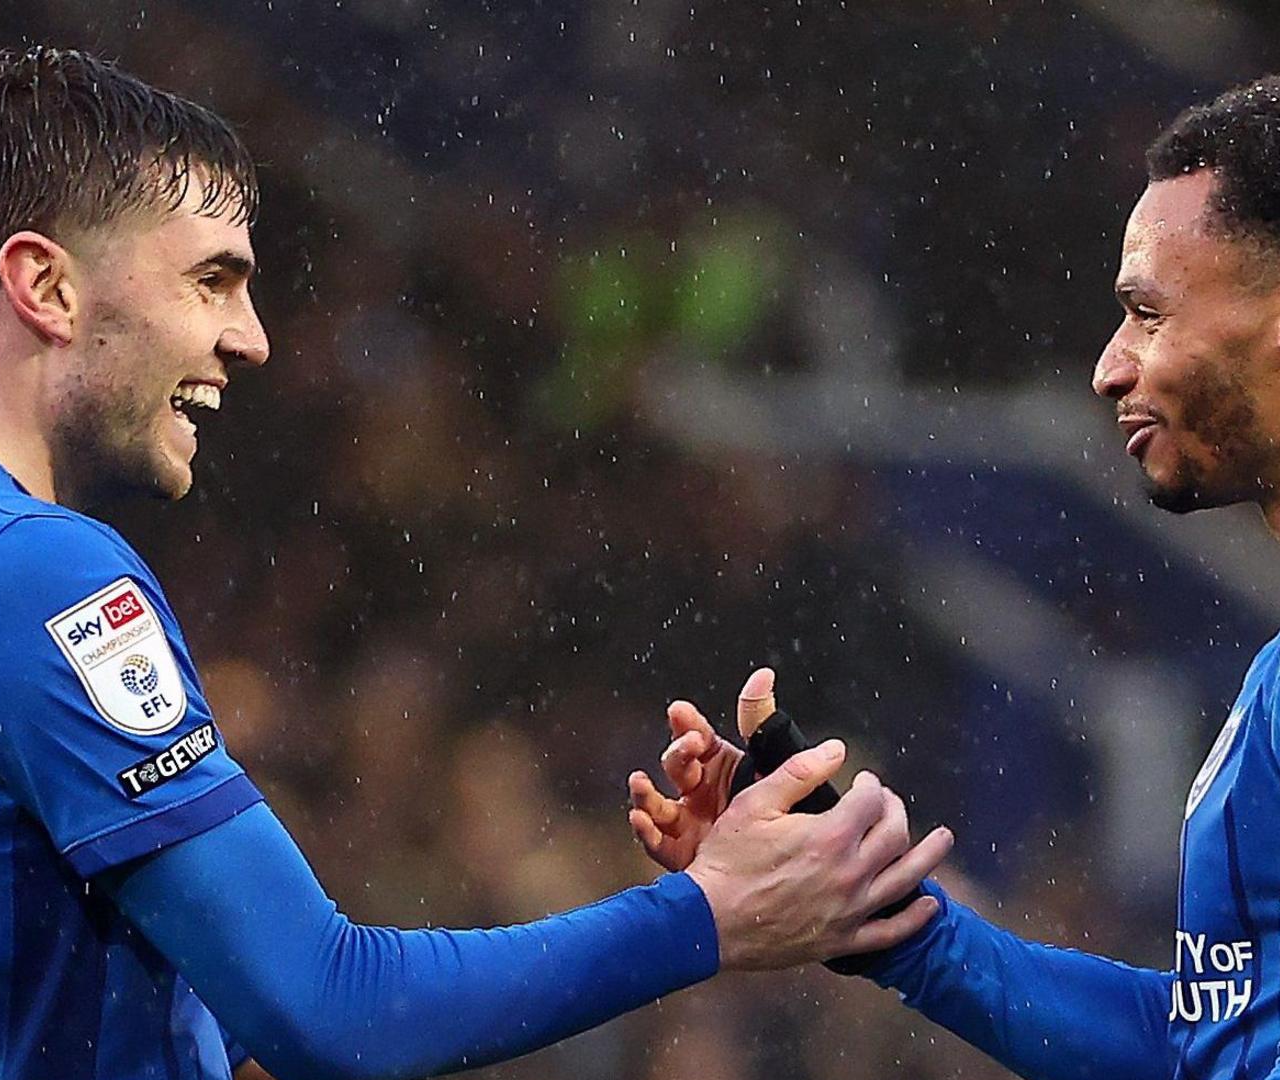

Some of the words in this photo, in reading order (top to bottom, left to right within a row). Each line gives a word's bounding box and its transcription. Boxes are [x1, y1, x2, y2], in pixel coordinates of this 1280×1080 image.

[68, 616, 102, 646] sky
[104, 595, 140, 622] bet
[82, 619, 152, 665] CHAMPIONSHIP
[140, 694, 172, 718] EFL
[1209, 941, 1253, 972] OF
